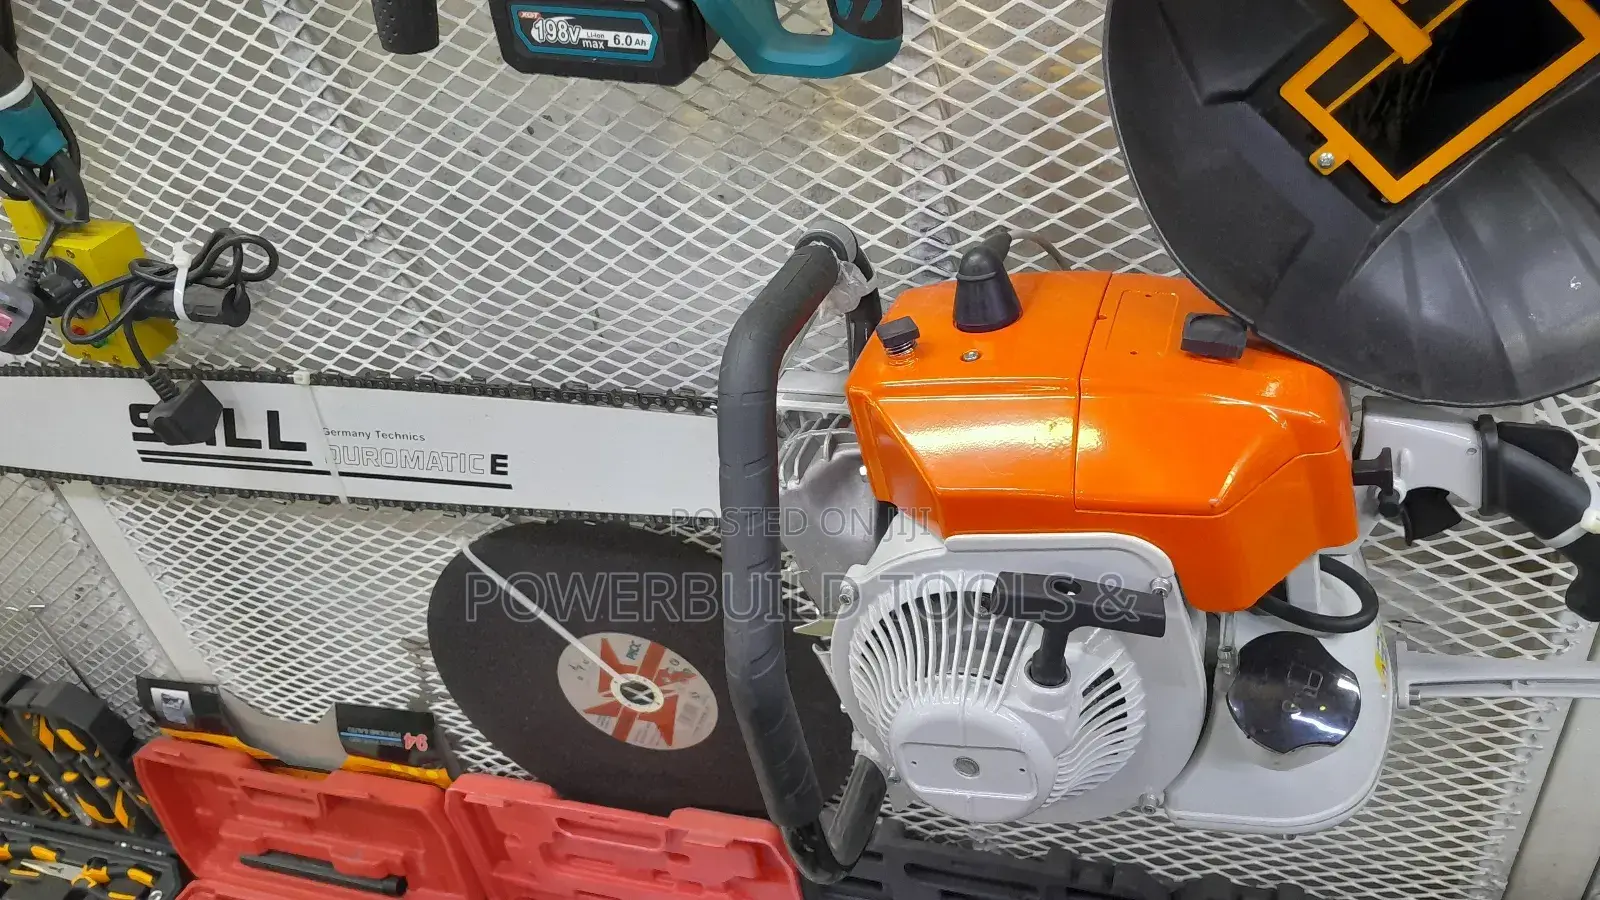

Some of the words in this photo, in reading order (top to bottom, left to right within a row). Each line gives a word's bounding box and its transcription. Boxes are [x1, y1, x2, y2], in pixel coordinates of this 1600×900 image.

[582, 39, 605, 49] max
[613, 34, 633, 47] 6.0
[634, 39, 647, 47] Ah
[322, 427, 371, 440] Germany
[374, 430, 426, 442] Technics
[403, 732, 429, 752] 94
